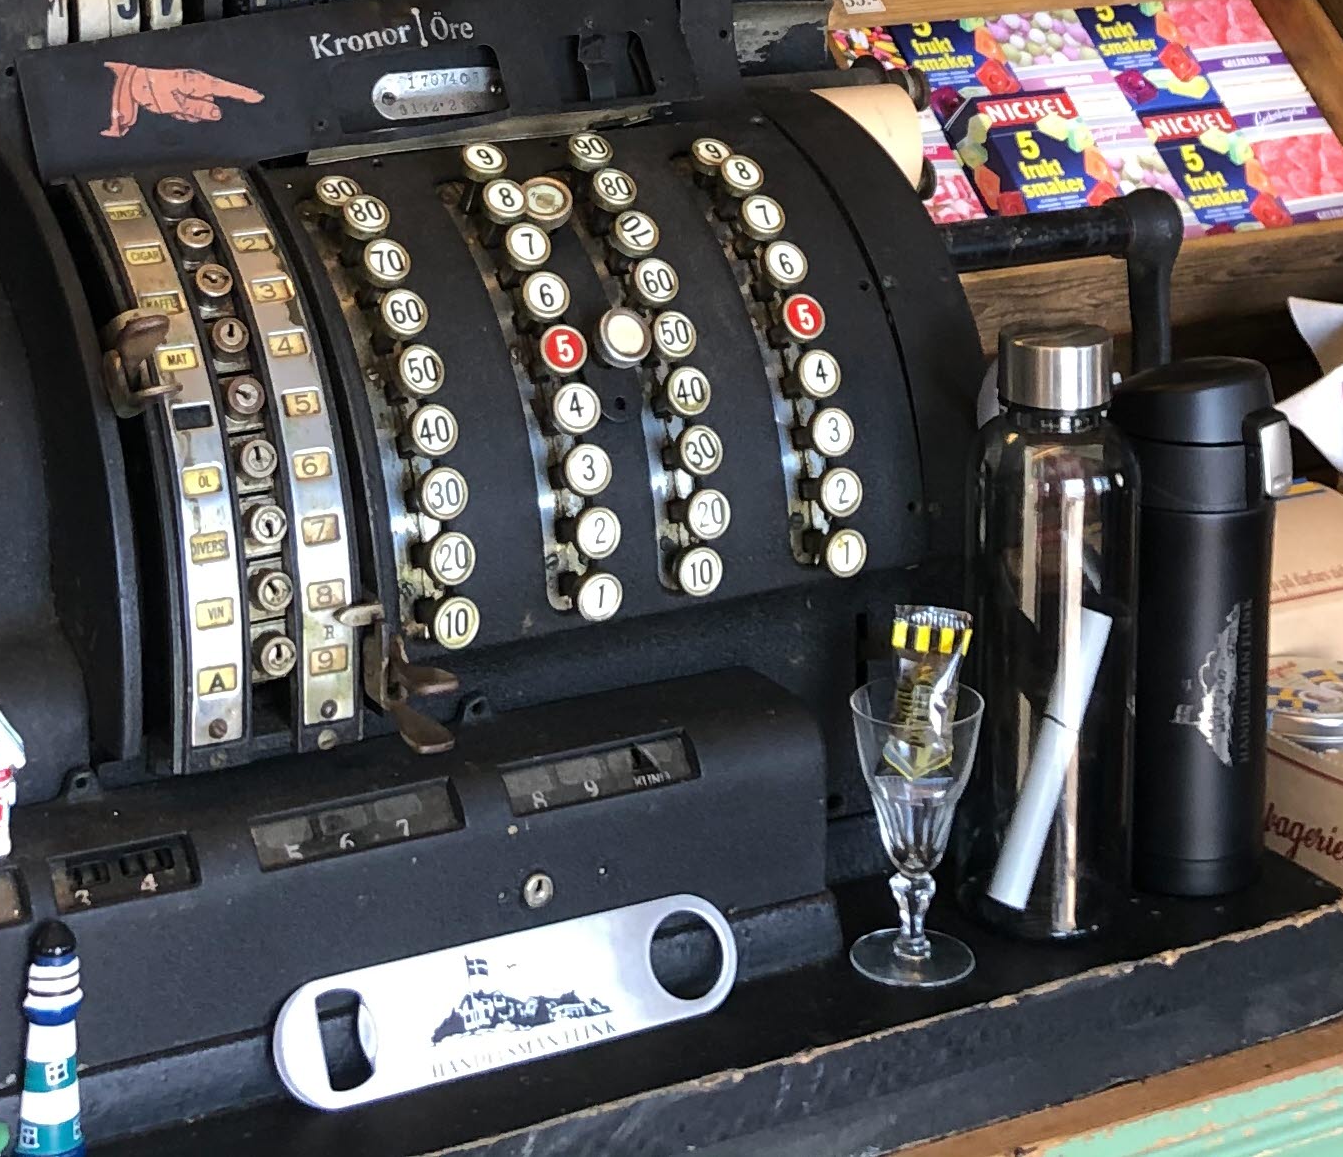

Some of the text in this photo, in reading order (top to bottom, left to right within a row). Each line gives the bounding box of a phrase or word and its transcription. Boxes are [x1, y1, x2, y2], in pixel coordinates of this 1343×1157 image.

[309, 11, 475, 60] Kronor Öre
[1095, 21, 1138, 40] frukt
[910, 37, 955, 56] frukt
[1099, 37, 1157, 56] smaker
[912, 53, 975, 72] smaker
[985, 96, 1073, 123] NICKEL
[1149, 112, 1233, 137] NICKEL
[578, 137, 606, 157] 90
[709, 144, 722, 160] 9
[1015, 130, 1041, 160] 5
[482, 147, 495, 167] 9
[1180, 144, 1205, 172] 5
[735, 160, 752, 181] 8
[1018, 159, 1065, 180] frukt
[1183, 171, 1229, 191] frukt
[325, 179, 353, 200] 90
[499, 187, 515, 208] 8
[601, 177, 631, 197] 80
[1021, 177, 1086, 200] smaker
[1187, 188, 1248, 209] smaker
[351, 200, 380, 223] 80
[755, 203, 772, 226] 7
[242, 237, 257, 251] 2
[520, 233, 536, 255] 7
[370, 248, 404, 273] 70
[778, 253, 795, 276] 6
[260, 284, 276, 299] 3
[643, 268, 674, 294] 60
[538, 282, 555, 308] 6
[390, 298, 422, 324] 60
[797, 304, 815, 330] 5
[659, 320, 689, 346] 50
[277, 337, 294, 354] 4
[556, 334, 575, 362] 5
[166, 352, 188, 367] MAT
[407, 356, 438, 384] 50
[814, 360, 829, 385] 4
[676, 375, 706, 405] 40
[294, 395, 311, 413] 5
[568, 391, 585, 417] 4
[419, 415, 451, 444] 40
[827, 417, 842, 444] 3
[685, 433, 716, 465] 30
[302, 456, 319, 476] 6
[581, 454, 597, 482] 3
[429, 479, 460, 510] 30
[835, 478, 849, 504] 2
[697, 497, 724, 529] 20
[311, 521, 327, 540] 7
[594, 517, 608, 546] 2
[438, 544, 469, 573] 20
[690, 558, 715, 585] 10
[315, 585, 333, 605] 8
[207, 605, 224, 620] VIN
[444, 608, 470, 638] 10
[323, 626, 335, 639] R
[317, 651, 334, 670] 9
[209, 672, 226, 692] A
[530, 790, 549, 809] 8
[583, 779, 600, 799] 9
[338, 832, 355, 850] 6
[395, 818, 410, 837] 7
